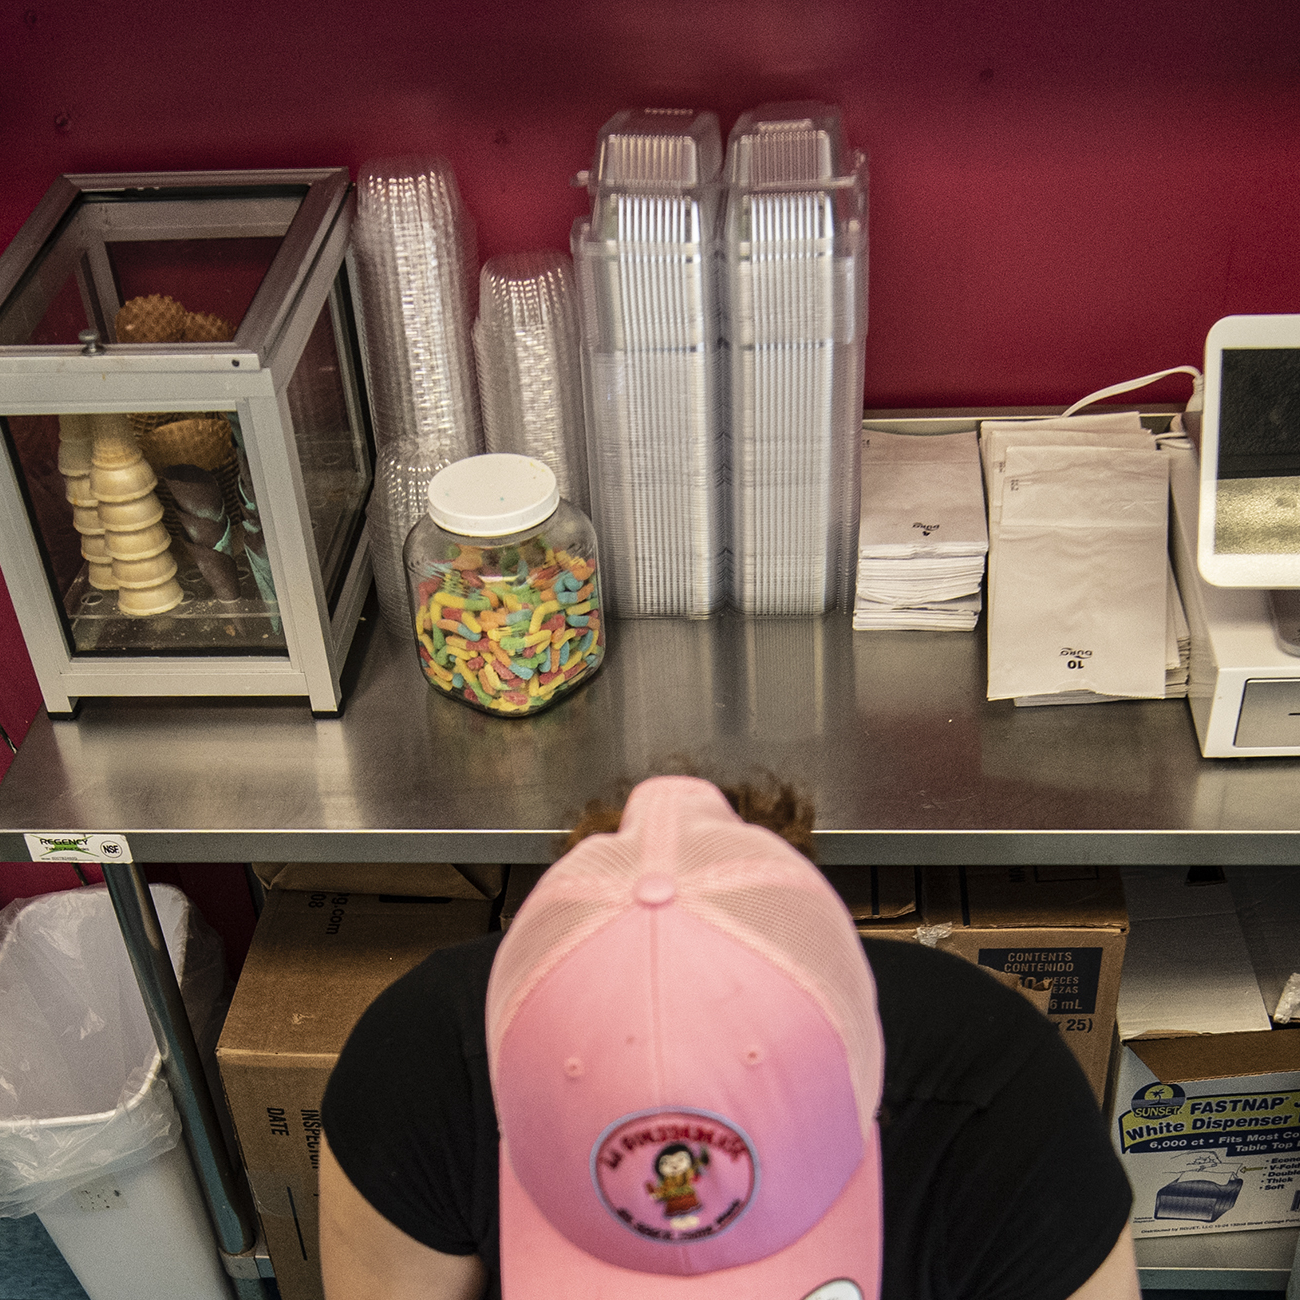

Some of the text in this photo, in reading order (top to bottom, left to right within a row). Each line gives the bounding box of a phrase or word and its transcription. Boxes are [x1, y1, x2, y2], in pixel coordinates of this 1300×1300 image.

[1058, 647, 1093, 659] DURO
[1067, 660, 1084, 670] 10
[40, 838, 88, 846] REGENCY
[103, 845, 119, 854] NSF
[1008, 952, 1072, 962] CONTENTS
[1004, 963, 1074, 972] CONTENIDO
[1052, 986, 1078, 994] EZAS
[1049, 998, 1083, 1010] 6 mL
[1066, 1018, 1093, 1033] 25)
[1133, 1103, 1182, 1118] SUNSET
[266, 1107, 289, 1137] DATE
[1126, 1121, 1185, 1141] White
[1191, 1112, 1292, 1131] Dispenser
[1149, 1138, 1187, 1149] 6,000
[1191, 1138, 1205, 1147] ct
[1219, 1135, 1242, 1145] Fits
[1247, 1131, 1279, 1142] Most
[1235, 1143, 1266, 1152] Table
[1270, 1140, 1294, 1151] Top
[1266, 1176, 1294, 1184] Thick
